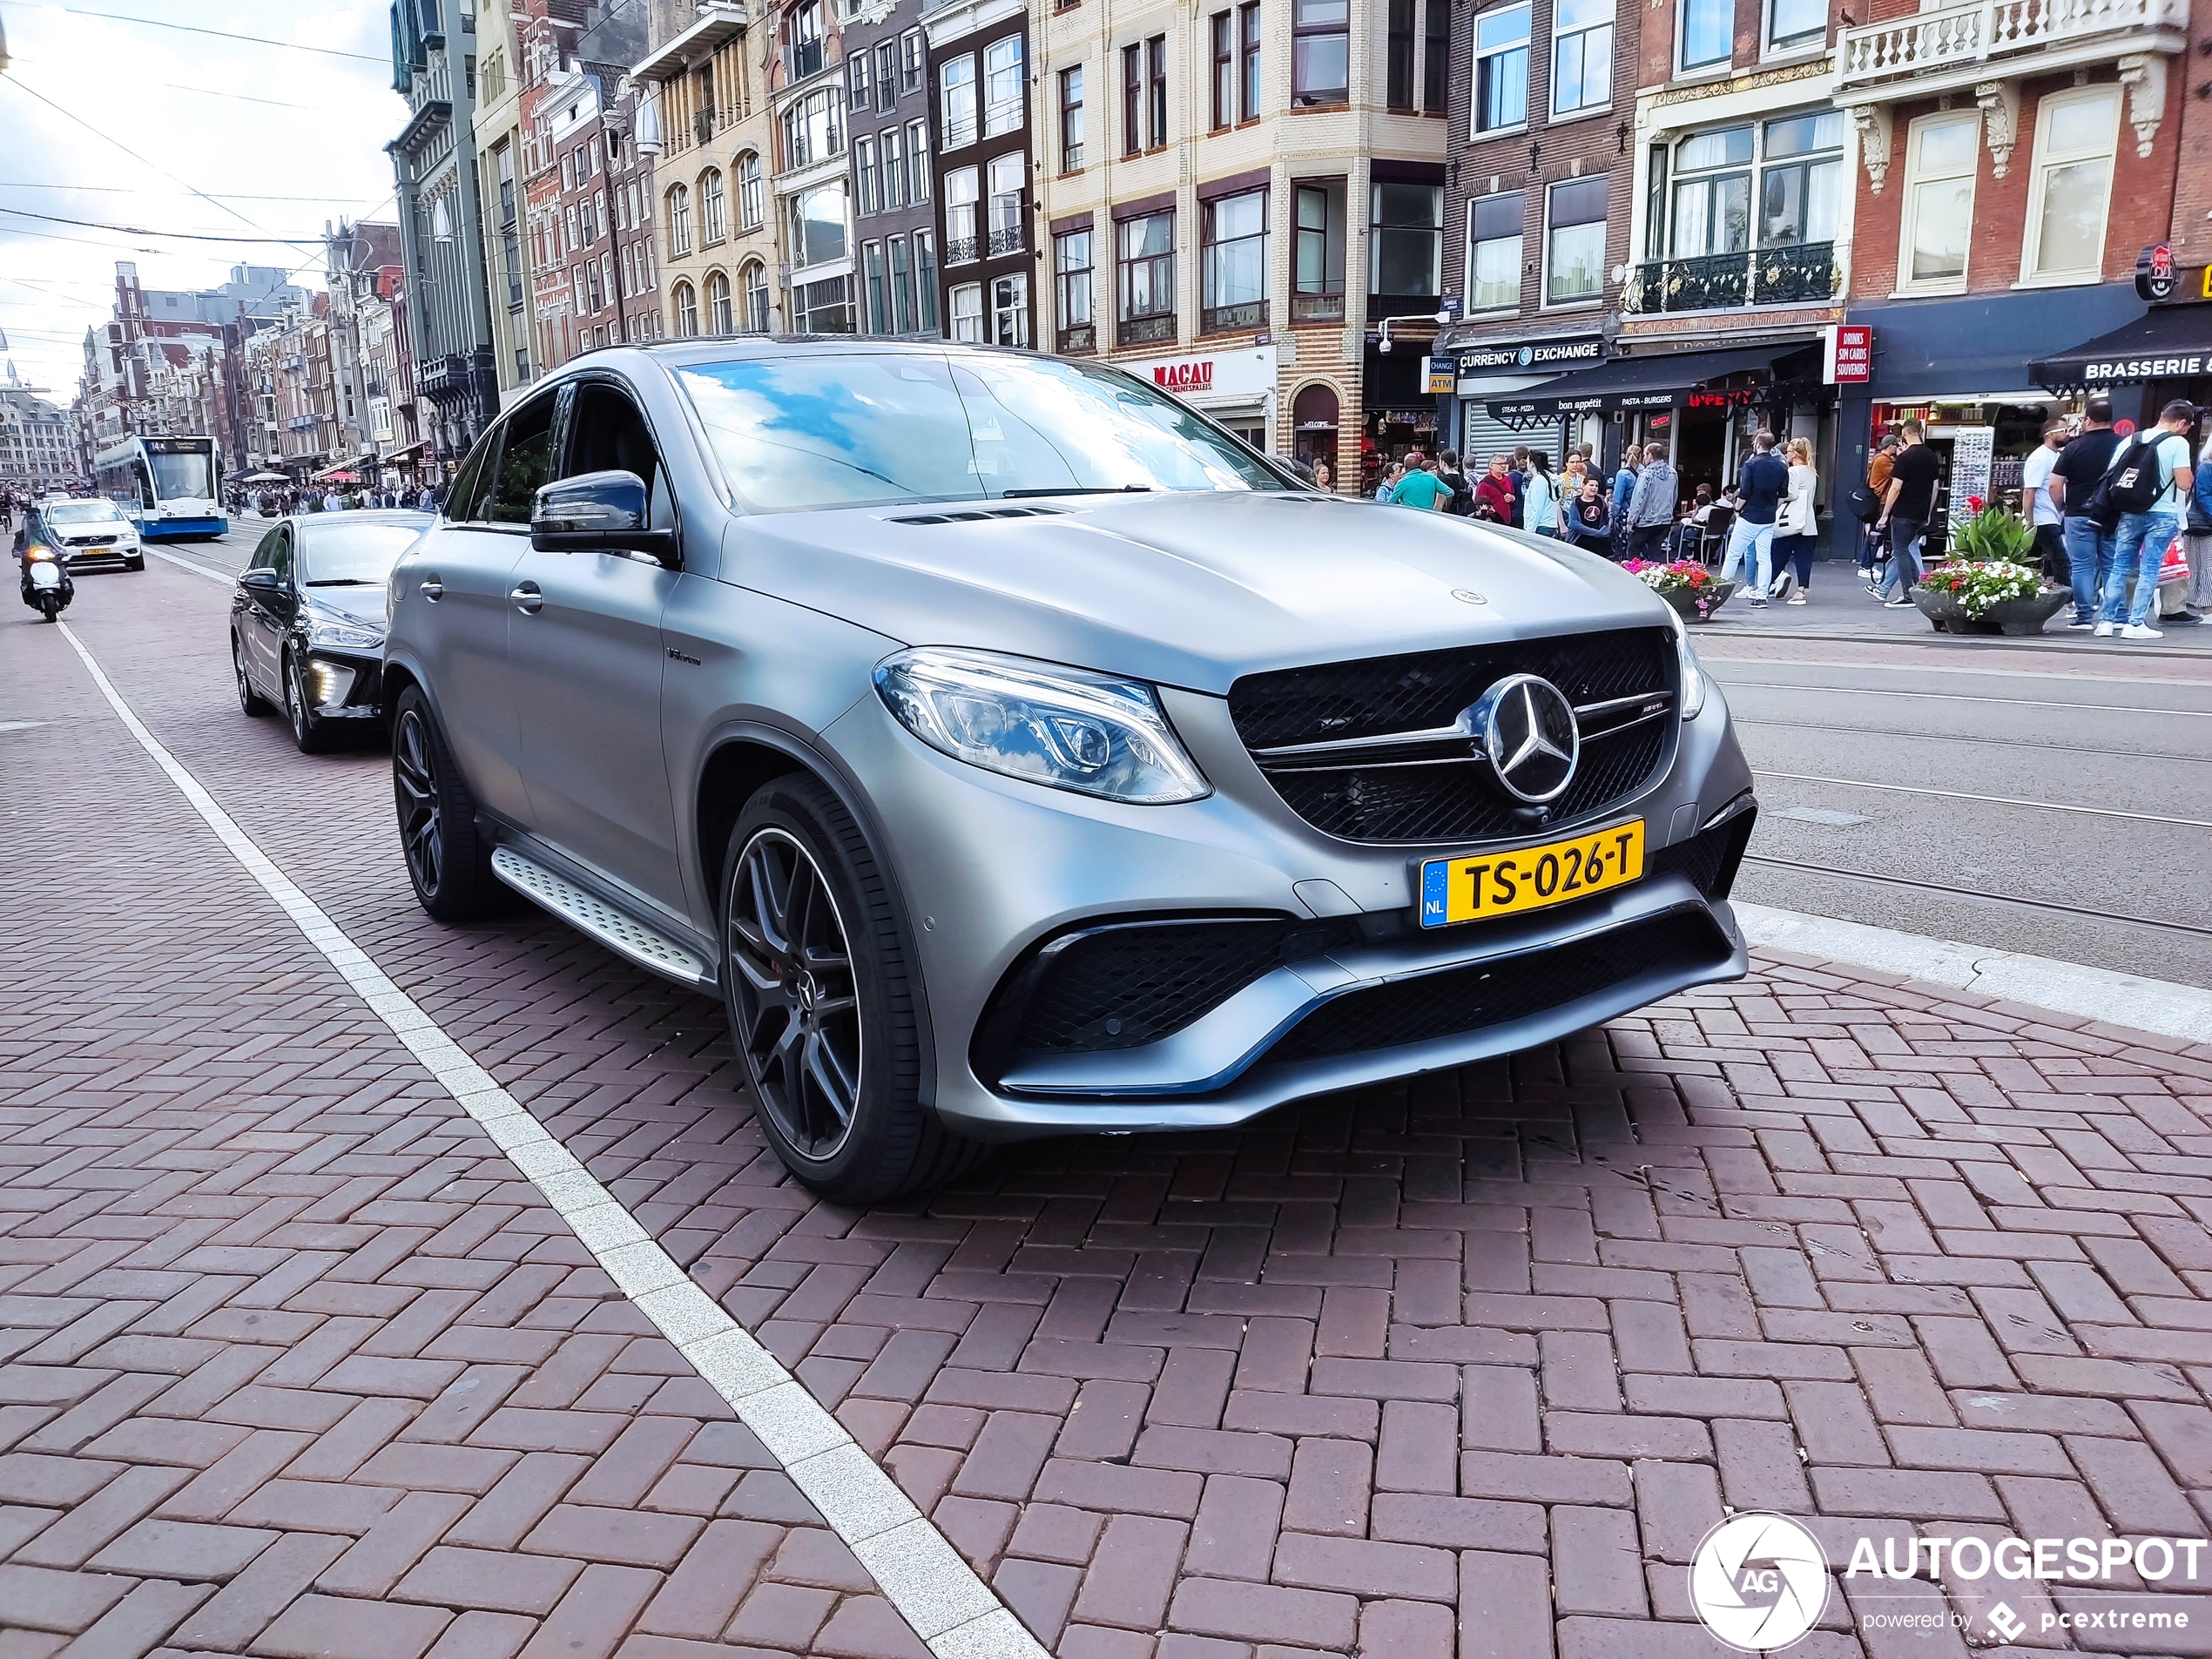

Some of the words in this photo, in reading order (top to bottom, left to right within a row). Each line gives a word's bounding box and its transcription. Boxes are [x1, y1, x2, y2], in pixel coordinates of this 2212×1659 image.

[1844, 333, 1864, 345] DRINKS
[1460, 352, 1516, 368] CURRENCY
[1534, 344, 1599, 361] EXCHANGE
[1838, 347, 1849, 360] SIM
[1850, 347, 1866, 360] CARDS
[1153, 361, 1214, 387] MACAU
[1837, 363, 1866, 375] SOUVENIRS
[2086, 358, 2201, 380] BRASSERIE
[1431, 380, 1452, 388] ATM
[1558, 400, 1573, 410] bon
[1575, 398, 1602, 410] appétit
[1644, 395, 1673, 405] BURGERS
[1466, 832, 1633, 910] TS-026-T
[1426, 900, 1444, 914] NL
